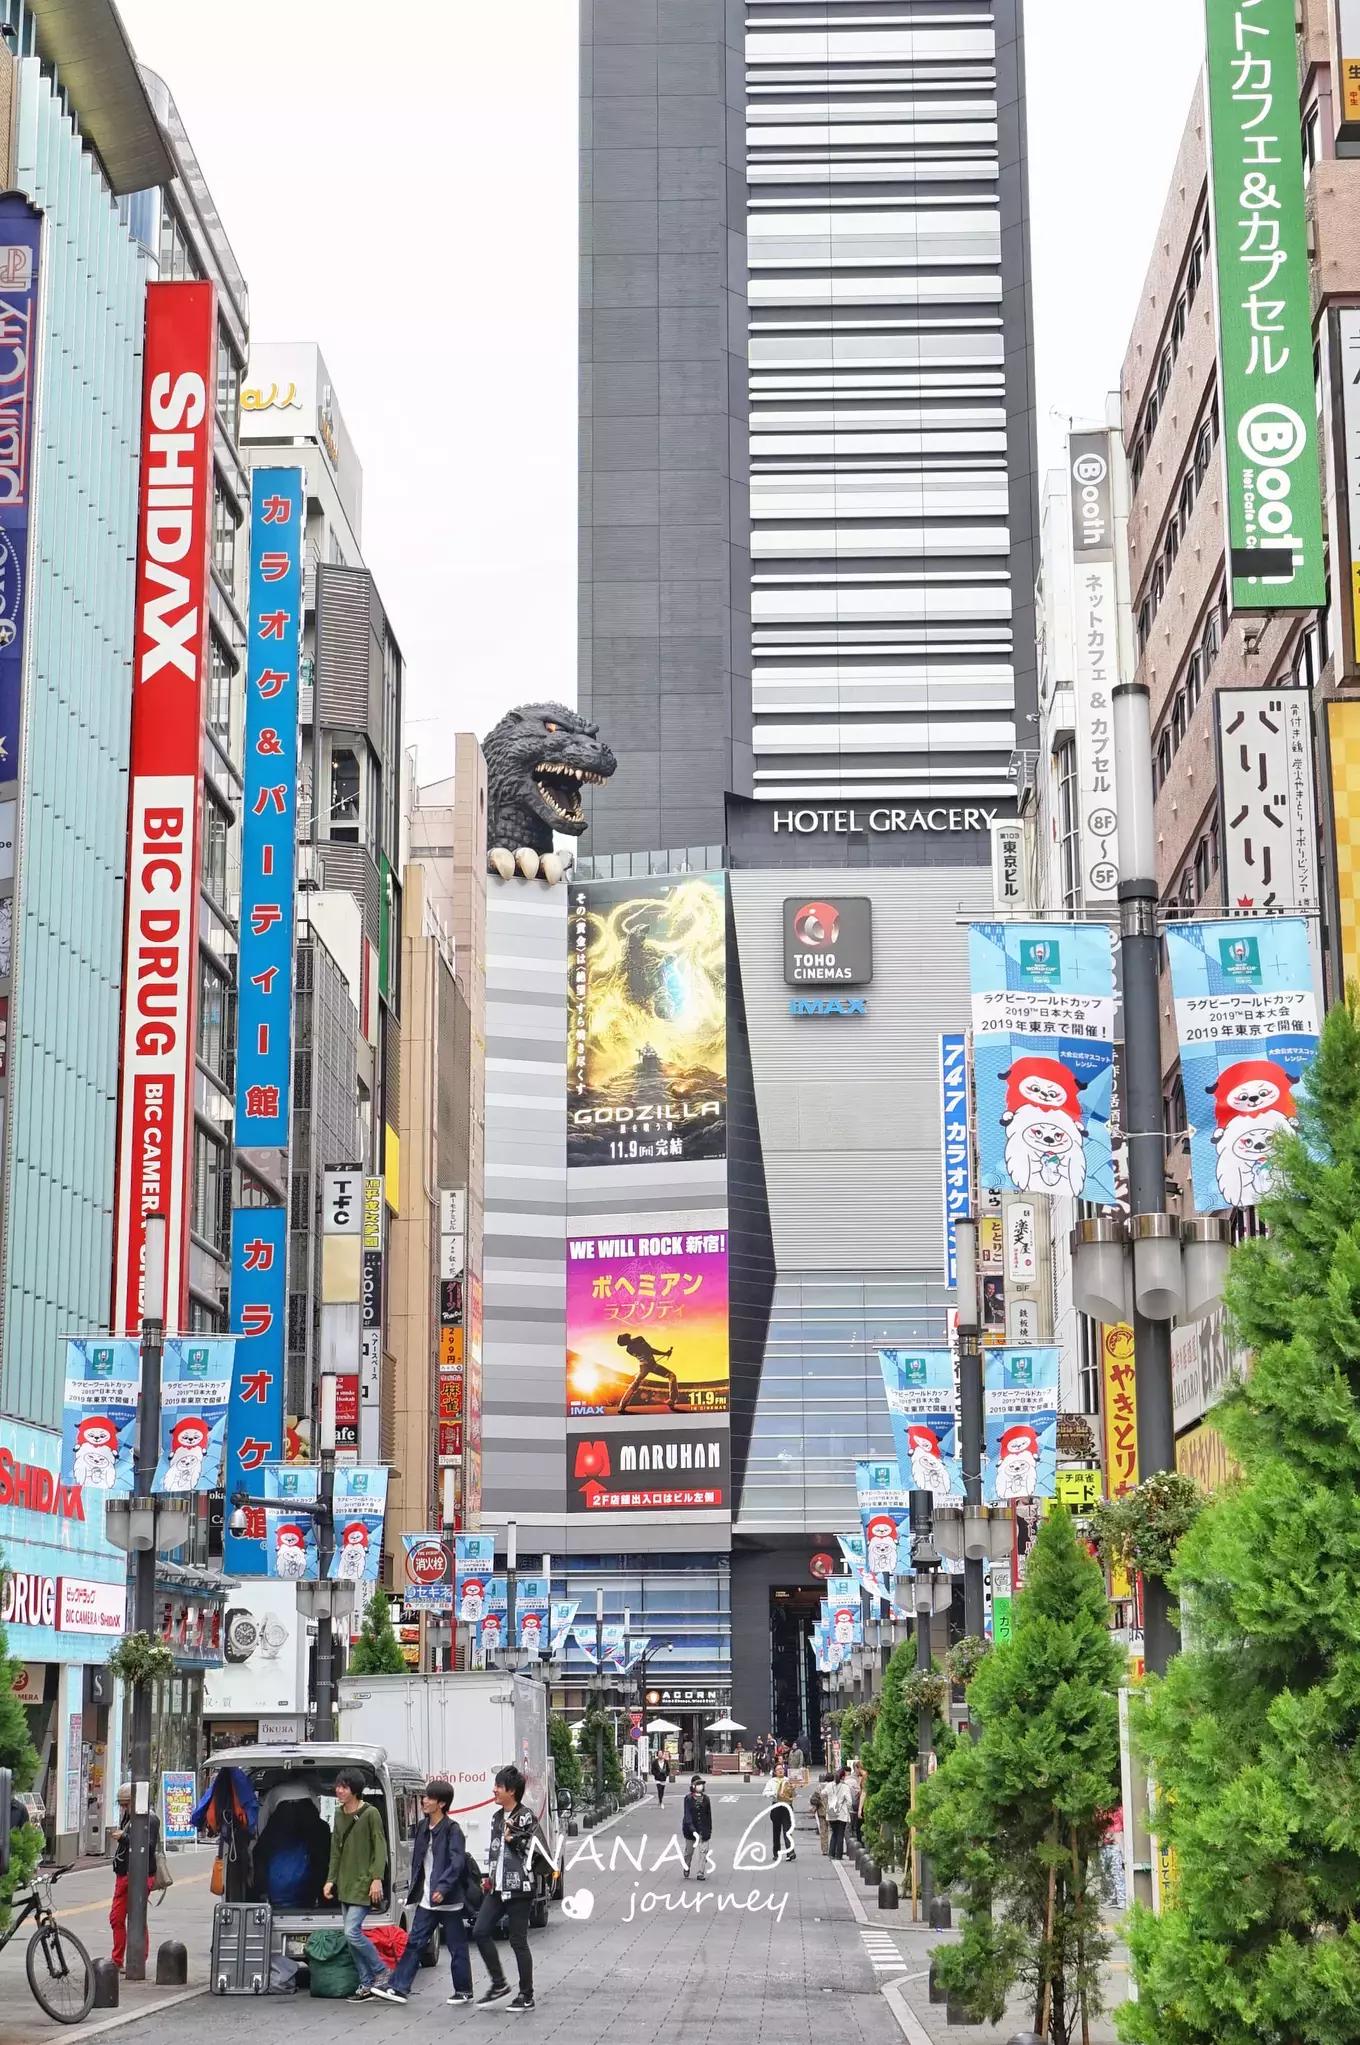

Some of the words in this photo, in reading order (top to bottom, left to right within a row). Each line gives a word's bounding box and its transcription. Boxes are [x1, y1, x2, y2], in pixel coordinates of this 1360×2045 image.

[1231, 0, 1289, 374] トカフェ&カプセル
[1073, 453, 1107, 544] Booth
[141, 371, 206, 683] SHIDAX
[1092, 718, 1111, 793] カプセル
[774, 810, 863, 832] HOTEL
[869, 809, 997, 831] GRACERY
[141, 807, 184, 894] BIC
[1003, 841, 1019, 896] 東京ビル
[794, 954, 836, 967] TOHO
[135, 909, 181, 1056] DRUG
[794, 968, 852, 979] CINEMAS
[789, 998, 868, 1015] IMAX
[984, 993, 1101, 1009] ラグビーワールドカップ
[1187, 994, 1305, 1011] ラグビーワールドカップ
[944, 1045, 967, 1112] 747
[144, 1083, 163, 1122] BIC
[574, 1101, 720, 1124] GODZILLA
[610, 1141, 637, 1159] 11.9
[656, 1138, 684, 1156] 完結
[140, 1127, 162, 1229] CAMER
[570, 1241, 594, 1259] WE
[598, 1239, 636, 1258] WILL
[639, 1237, 683, 1256] ROCK
[363, 1267, 374, 1319] COCO
[592, 1273, 703, 1299] ボヘミアン
[447, 1328, 456, 1364] 299円
[440, 1382, 461, 1413] 麻雀
[689, 1392, 715, 1405] 11.9
[715, 1396, 727, 1404] FRI
[571, 1406, 604, 1415] IMAX
[336, 1427, 355, 1440] afe
[620, 1443, 720, 1470] MARUHAN
[0, 1446, 85, 1521] SHIDAX
[416, 1556, 444, 1571] 消火栓
[417, 1586, 451, 1598] セキネ
[66, 1609, 75, 1624] BIC
[75, 1611, 97, 1626] CAMERA
[100, 1612, 121, 1628] SHIDAX
[459, 1771, 486, 1783] Food
